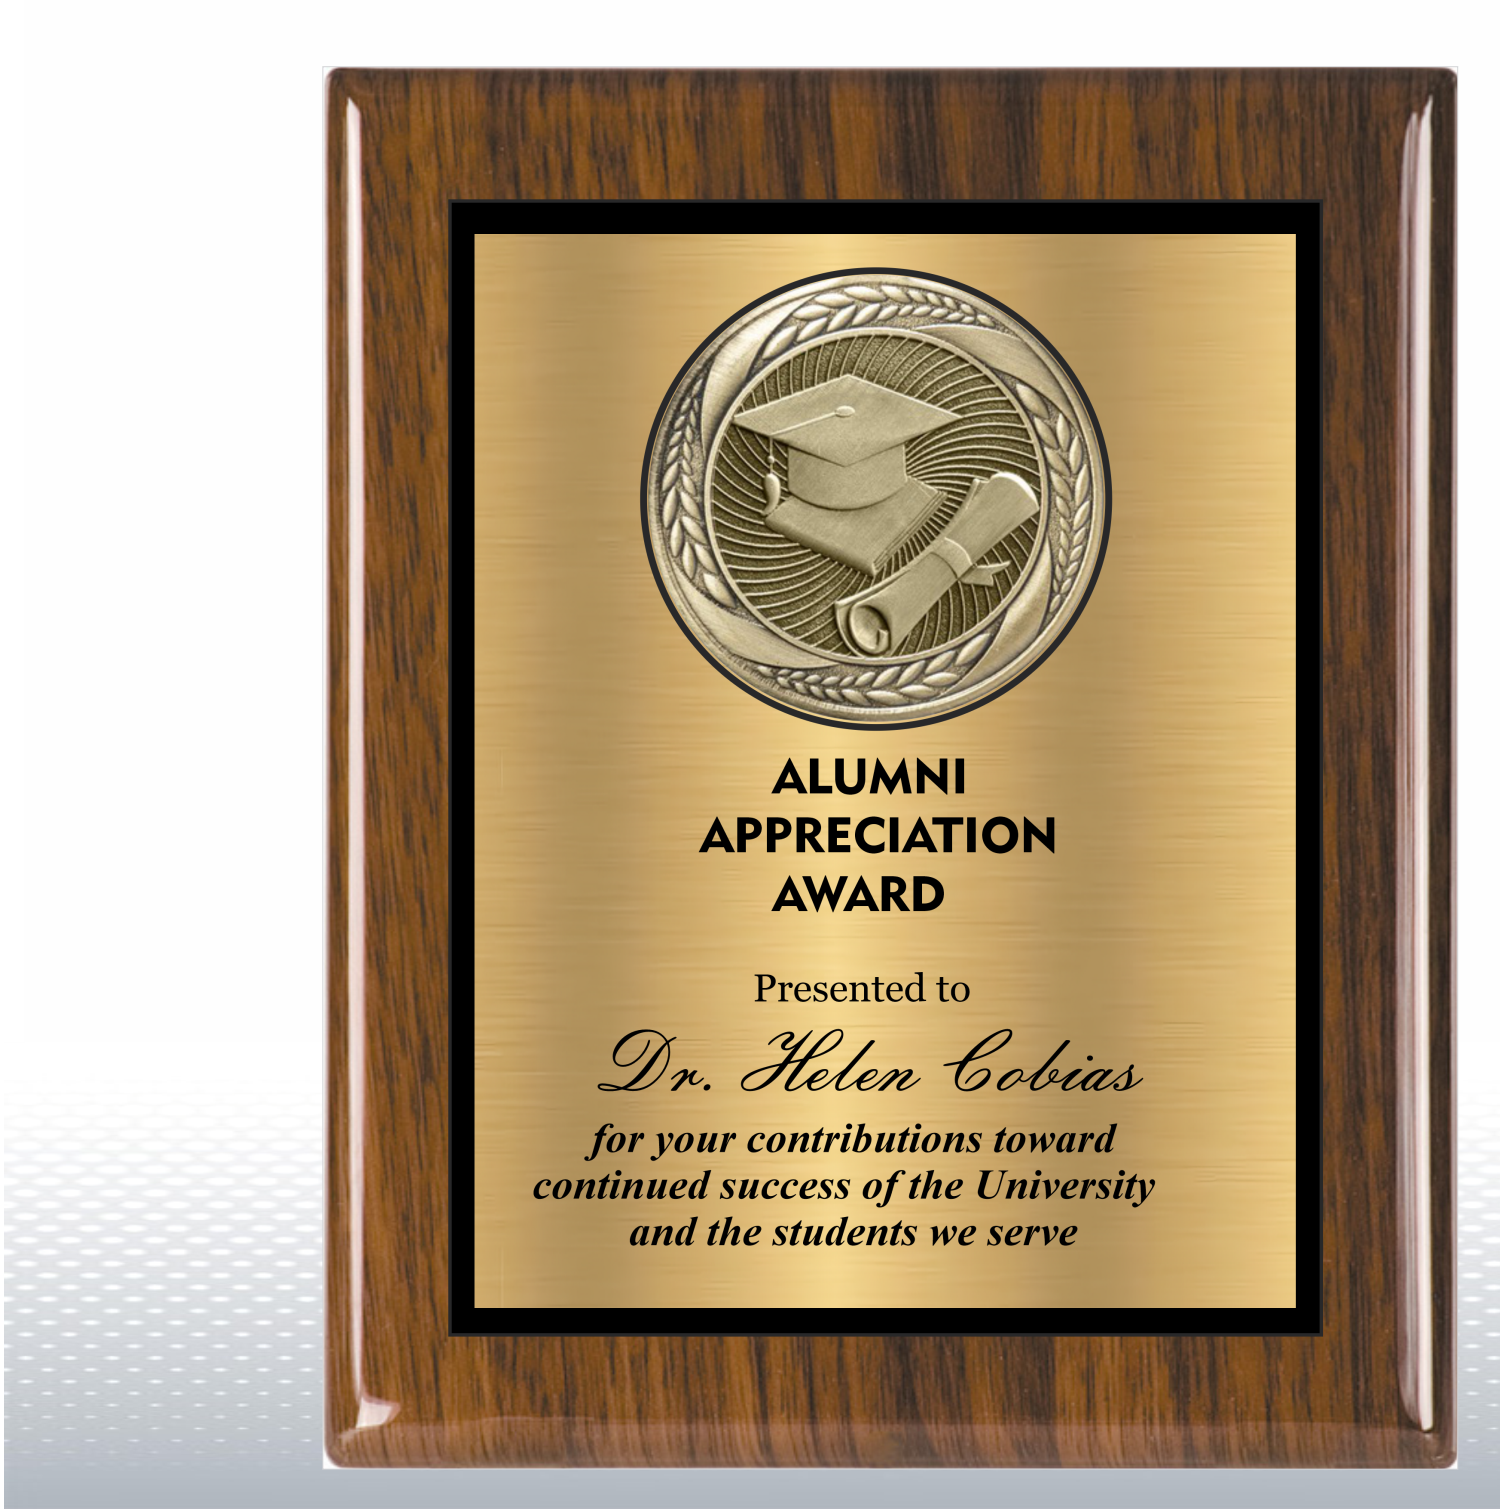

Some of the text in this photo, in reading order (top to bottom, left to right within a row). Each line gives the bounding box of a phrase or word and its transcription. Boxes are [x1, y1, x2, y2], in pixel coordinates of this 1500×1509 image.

[771, 757, 965, 795] ALUMNI
[698, 816, 1055, 854] APPRECIATION
[771, 875, 945, 913] AWARD
[754, 971, 970, 1003] Presented to
[597, 1028, 1144, 1092] Dr. Helen Cobias
[583, 1123, 1118, 1162] for your contributions toward
[533, 1169, 1156, 1208] continued success of the University
[629, 1216, 1078, 1247] and the students we serve
